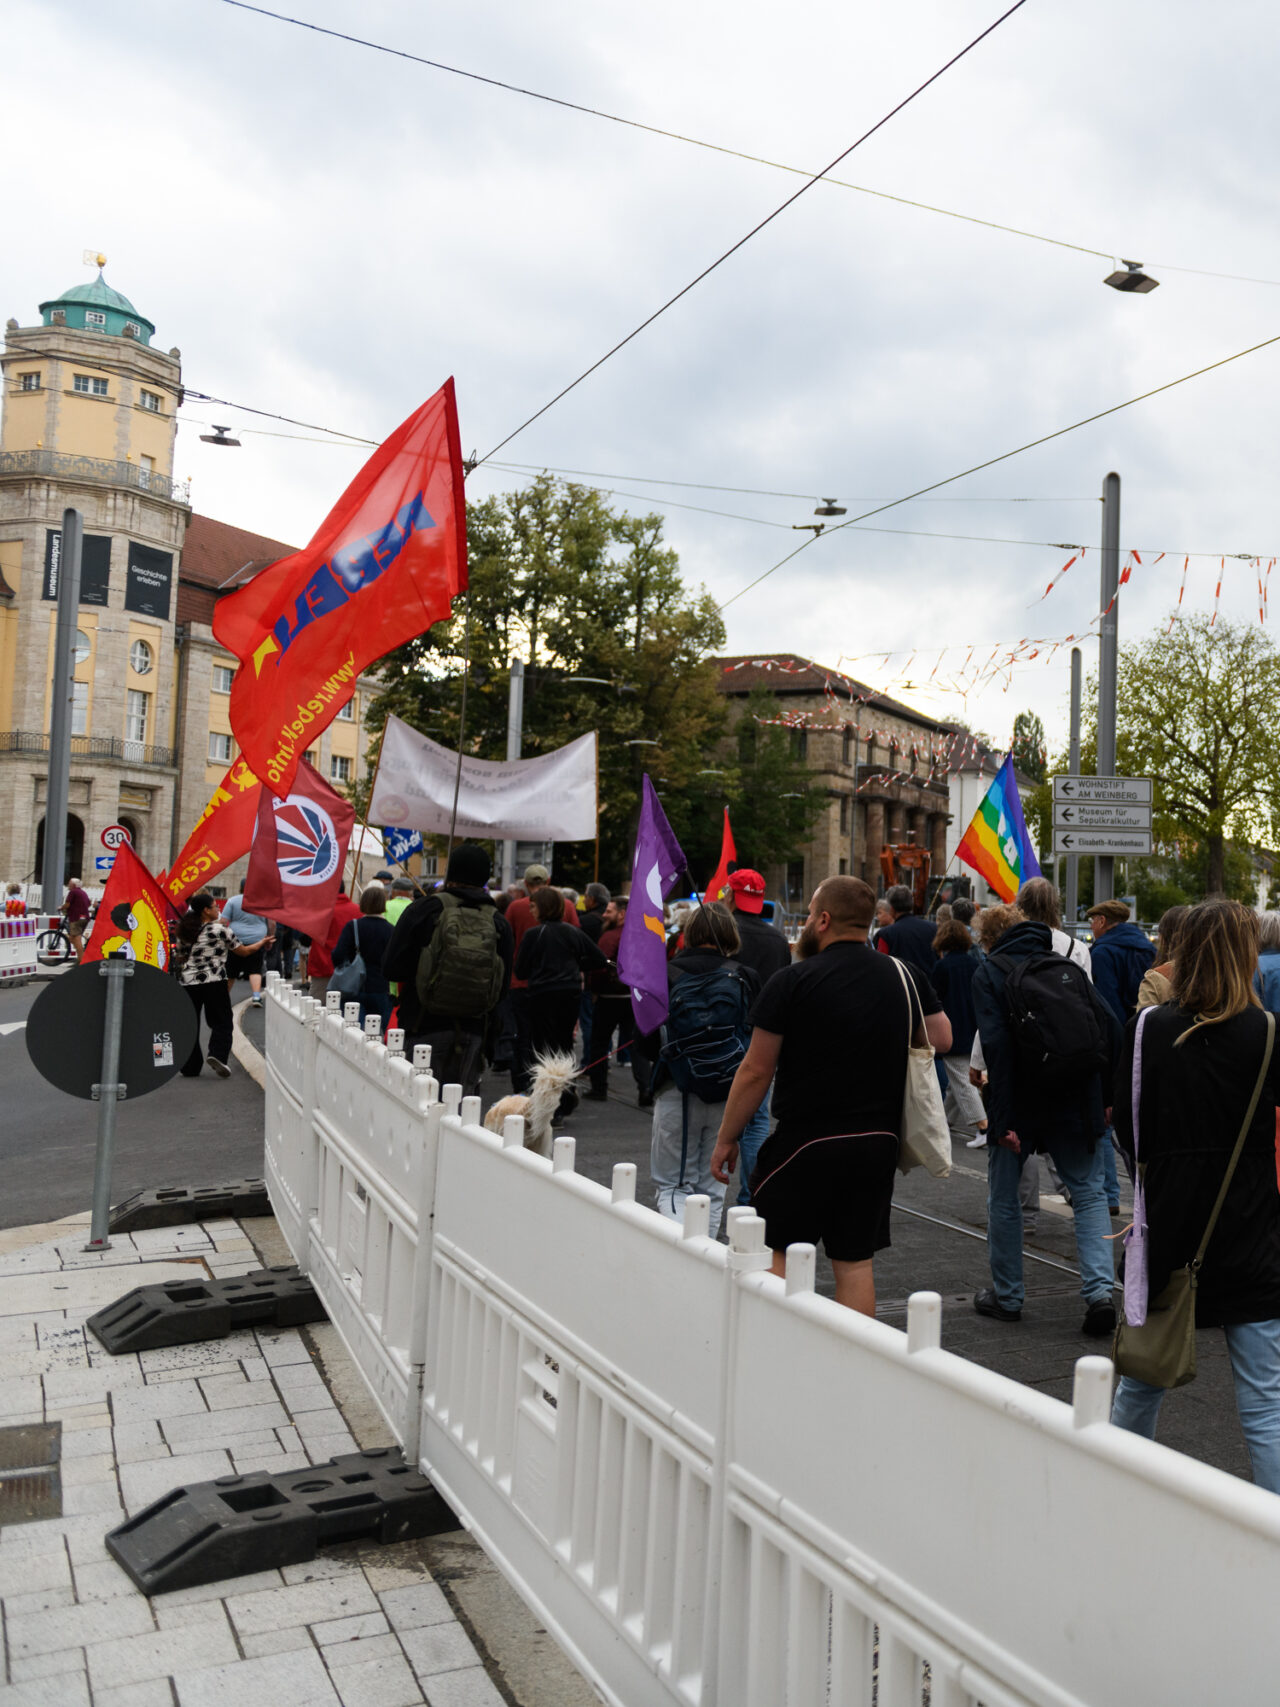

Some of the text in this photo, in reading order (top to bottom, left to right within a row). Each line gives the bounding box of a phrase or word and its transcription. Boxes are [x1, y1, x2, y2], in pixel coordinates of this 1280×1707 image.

[49, 534, 61, 597] Landesmuseum
[131, 565, 168, 581] Geschichte
[136, 575, 161, 587] erleben
[1078, 781, 1125, 789] WOHNSTIFT
[1094, 791, 1138, 799] WEINBERG
[1078, 807, 1127, 816] Museum für
[1078, 816, 1140, 826] Sepulkralkultur
[107, 832, 124, 845] 30
[1078, 838, 1144, 847] Elisabeth-Krankenhaus
[153, 1032, 171, 1043] KS
